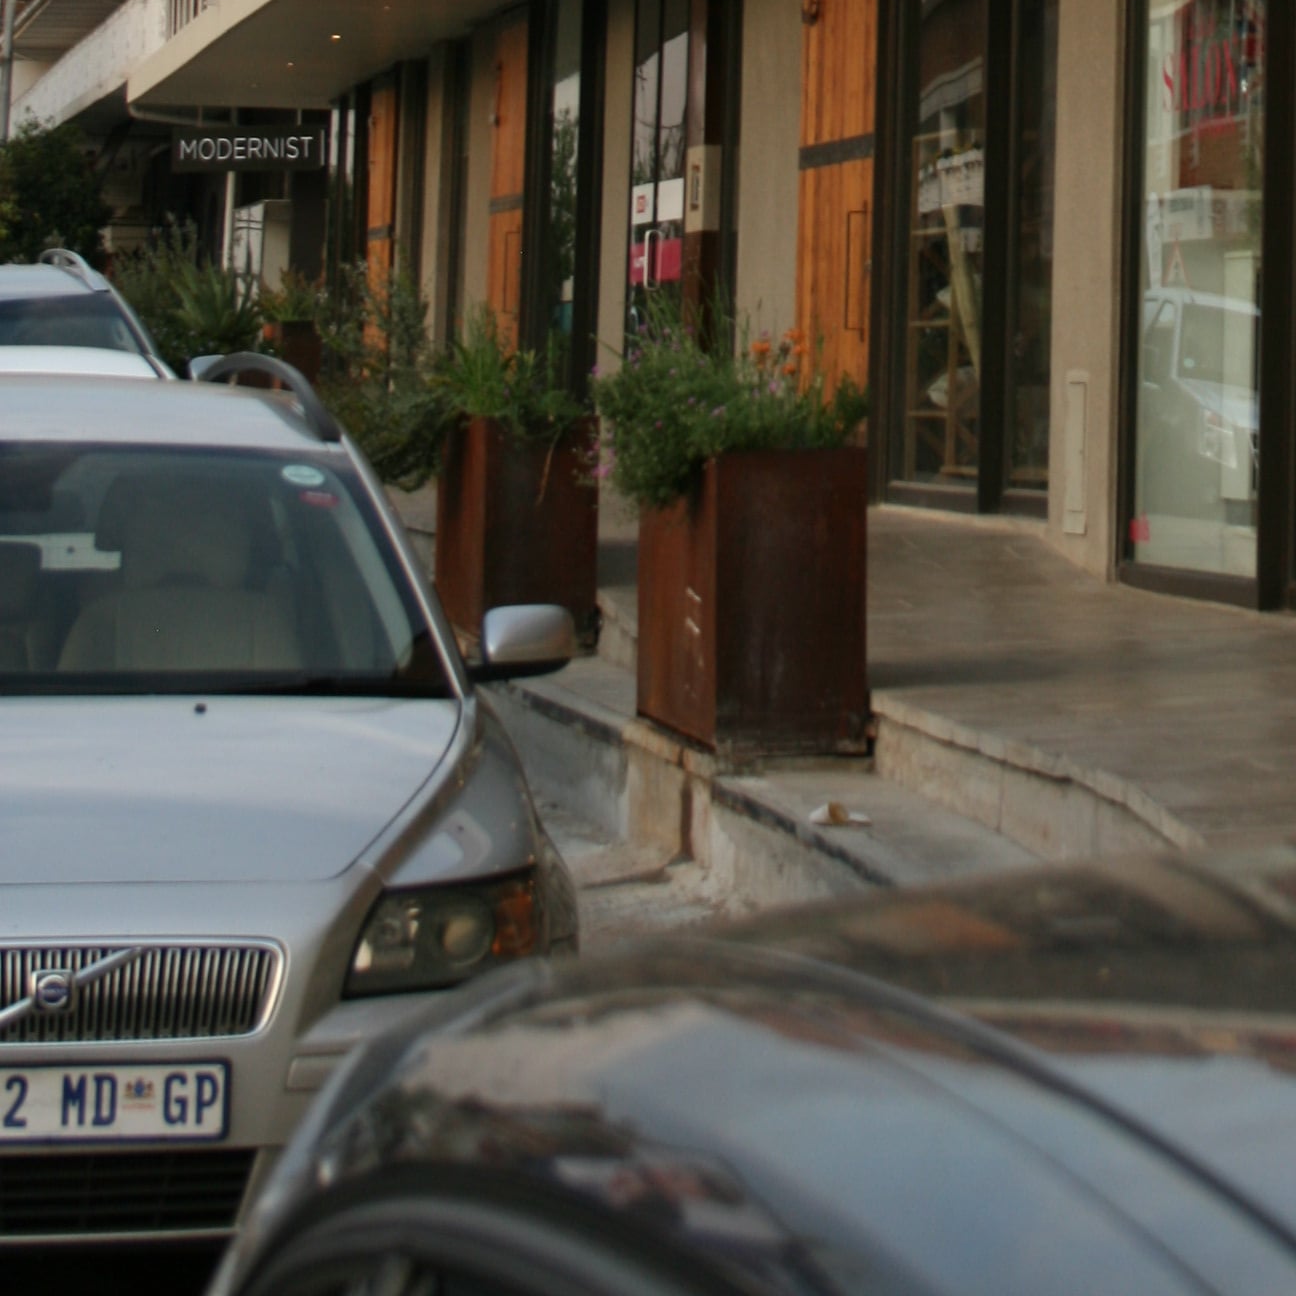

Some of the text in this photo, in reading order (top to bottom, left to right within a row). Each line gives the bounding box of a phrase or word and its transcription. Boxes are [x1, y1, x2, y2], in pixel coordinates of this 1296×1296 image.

[180, 136, 313, 160] MODERNIST
[3, 1070, 220, 1128] 2 MD GP
